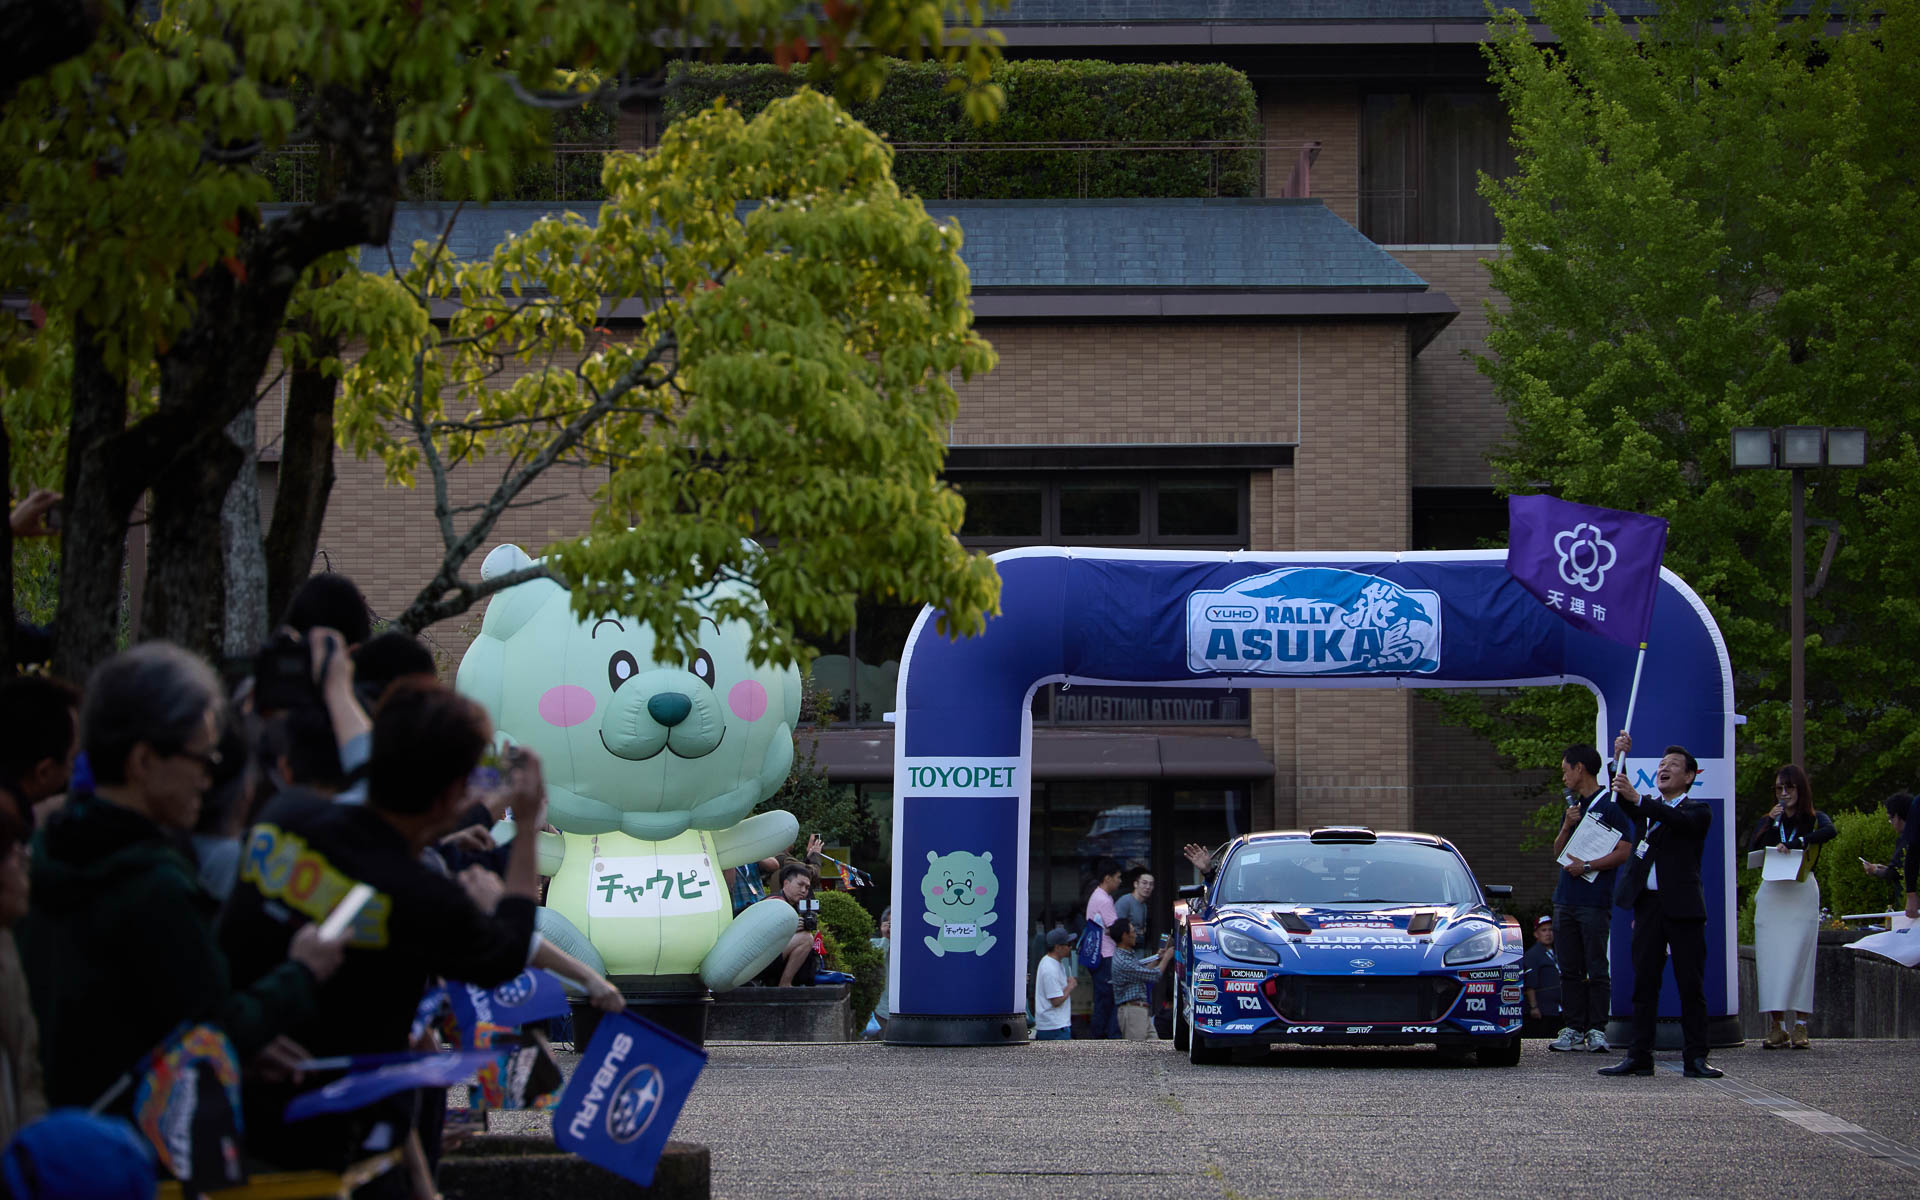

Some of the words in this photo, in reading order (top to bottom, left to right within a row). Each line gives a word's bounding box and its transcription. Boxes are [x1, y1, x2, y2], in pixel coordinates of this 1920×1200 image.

[1545, 589, 1607, 622] 天理市
[1212, 610, 1252, 619] YUHO
[1265, 606, 1335, 624] RALLY
[1205, 628, 1382, 663] ASUKA
[908, 766, 1017, 788] TOYOPET
[596, 868, 711, 903] チャウピー
[1305, 936, 1416, 944] SUBARU
[1230, 970, 1264, 979] YOKOHAMA
[1469, 971, 1500, 979] YOKOHAMA
[1226, 982, 1256, 992] MOTUL
[1467, 984, 1495, 993] MOTUL
[1237, 996, 1262, 1010] TOA
[1465, 998, 1486, 1011] TOA
[1195, 1004, 1222, 1015] NADEX
[1498, 1006, 1522, 1016] NADEX
[1286, 1026, 1325, 1034] KYB
[1401, 1026, 1437, 1034] KYB
[568, 1032, 635, 1141] SUBARU
